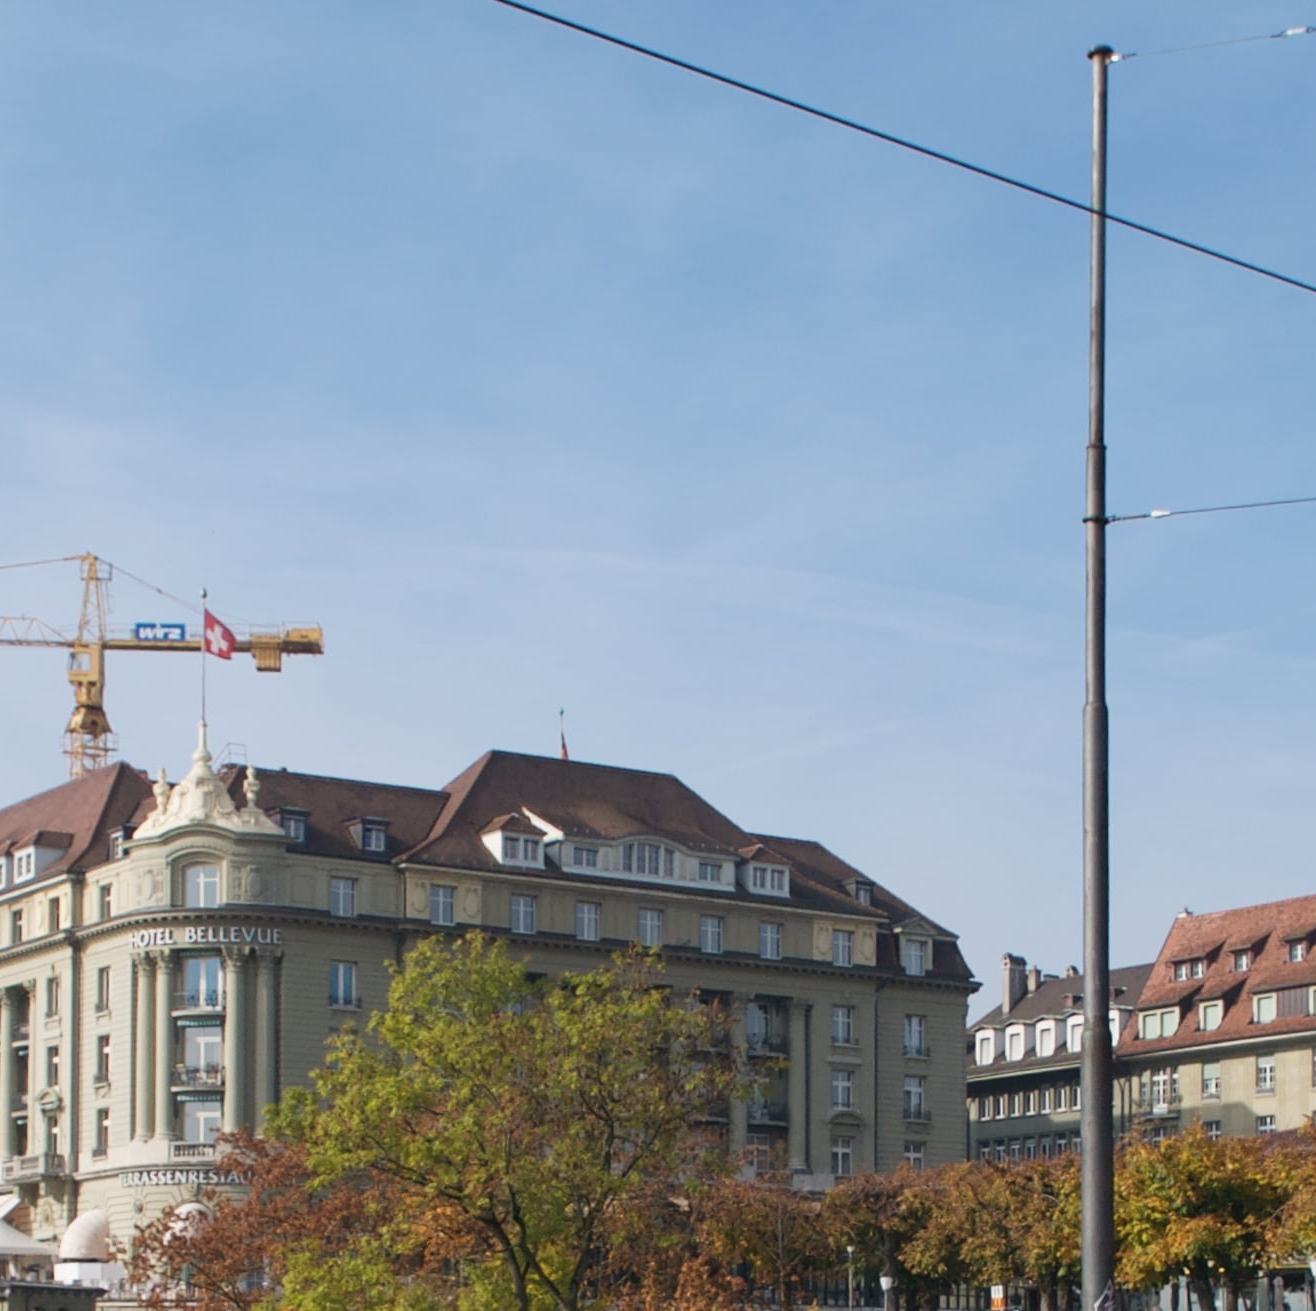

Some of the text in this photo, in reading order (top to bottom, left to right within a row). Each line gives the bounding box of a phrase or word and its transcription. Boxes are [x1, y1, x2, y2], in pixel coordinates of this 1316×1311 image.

[139, 624, 182, 640] wirz
[130, 926, 283, 948] HOTEL BELLEVUE
